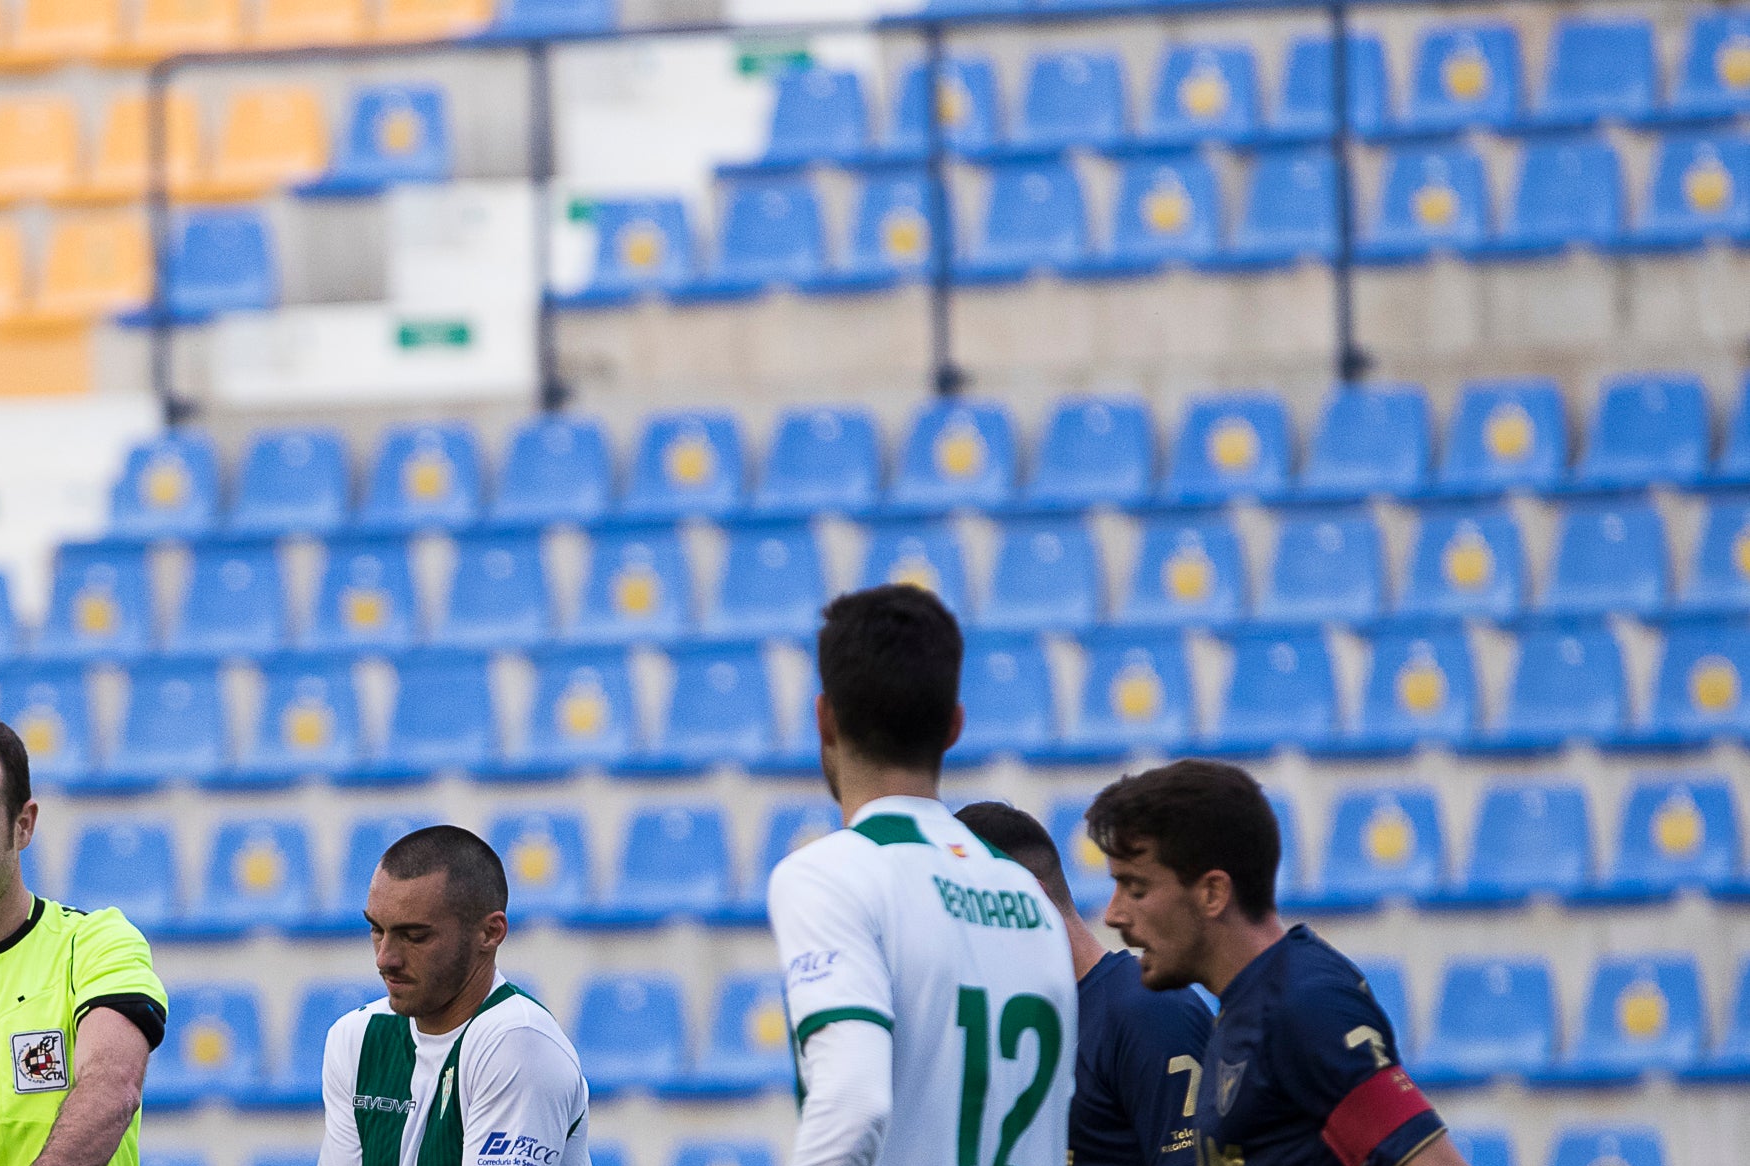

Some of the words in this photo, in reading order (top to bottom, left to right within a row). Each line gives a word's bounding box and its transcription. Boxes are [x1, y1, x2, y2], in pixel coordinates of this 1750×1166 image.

[1168, 1054, 1203, 1118] 7
[517, 1135, 539, 1144] GRUPO
[508, 1140, 559, 1165] PACC
